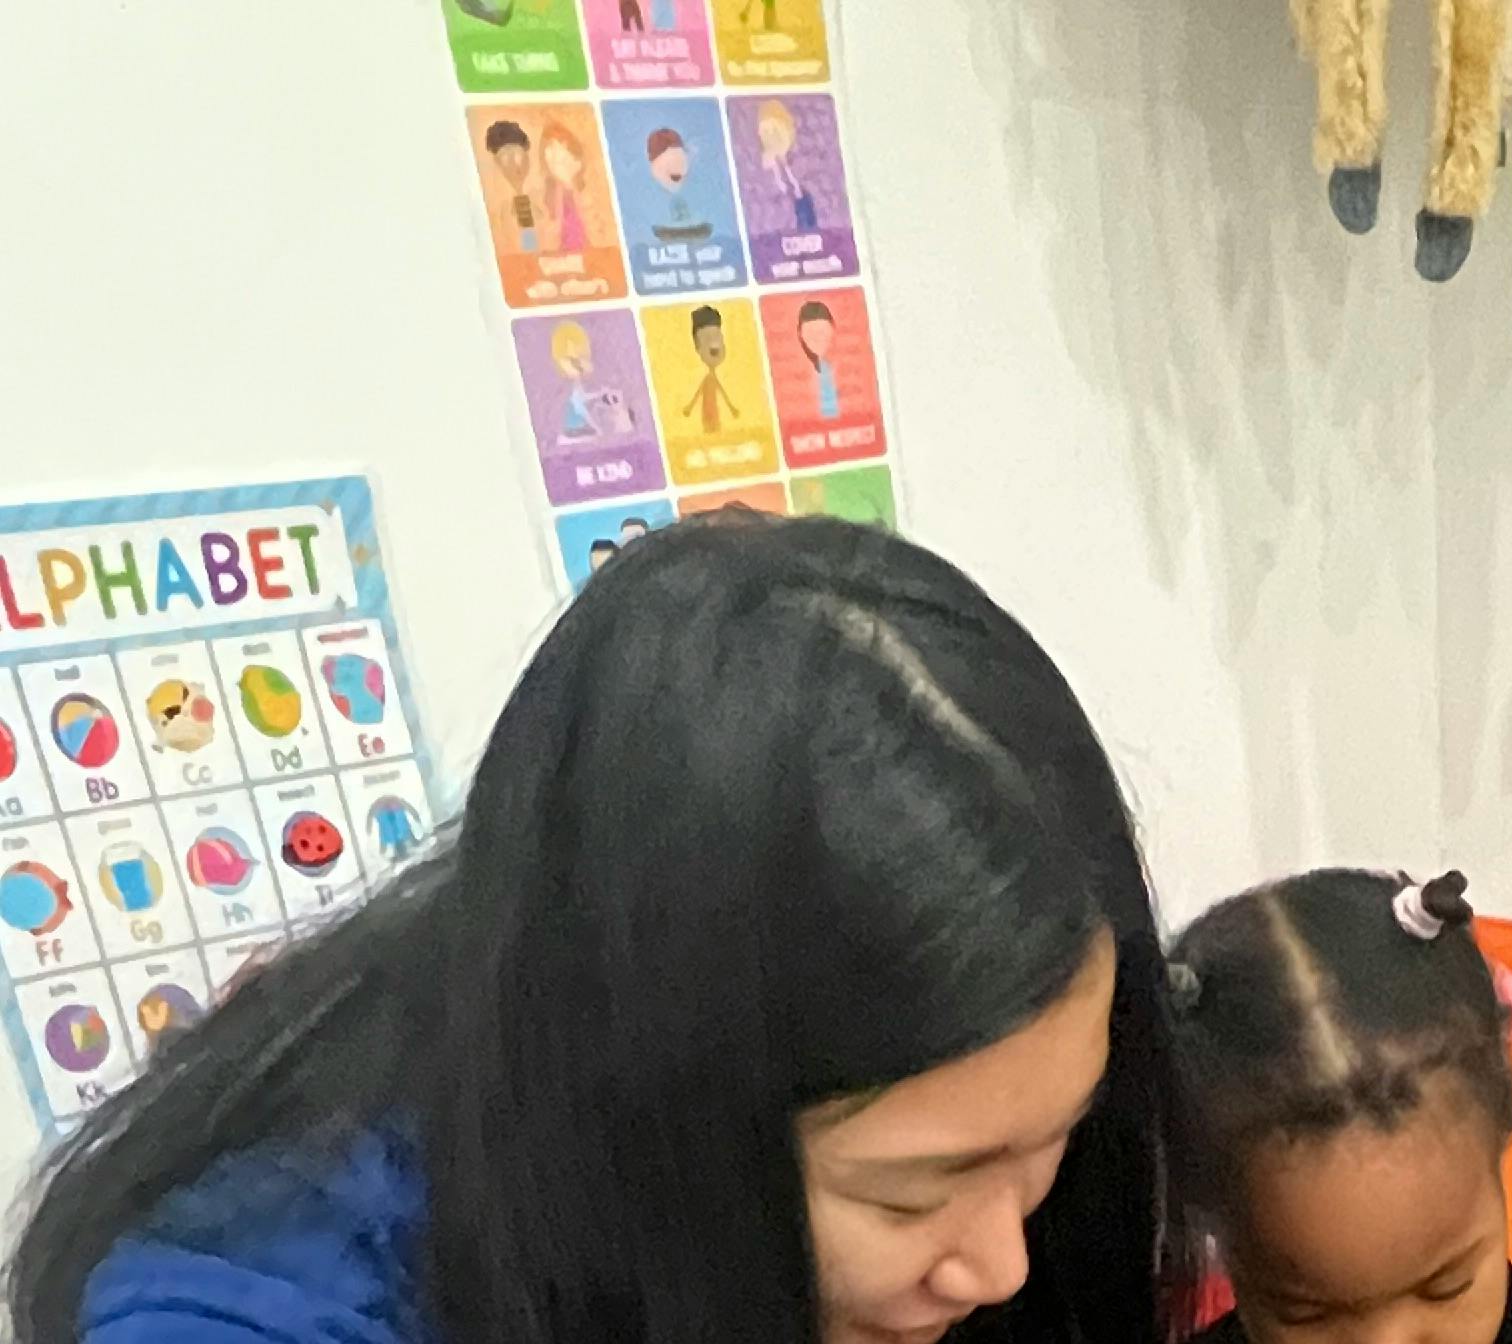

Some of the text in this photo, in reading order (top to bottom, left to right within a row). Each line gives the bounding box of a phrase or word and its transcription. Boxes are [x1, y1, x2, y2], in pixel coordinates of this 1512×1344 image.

[0, 523, 320, 630] LPHABET
[270, 745, 303, 772] Dd
[182, 762, 214, 786] Cc
[85, 776, 120, 803] Bb
[130, 919, 164, 944] Gg
[35, 938, 64, 967] Ff
